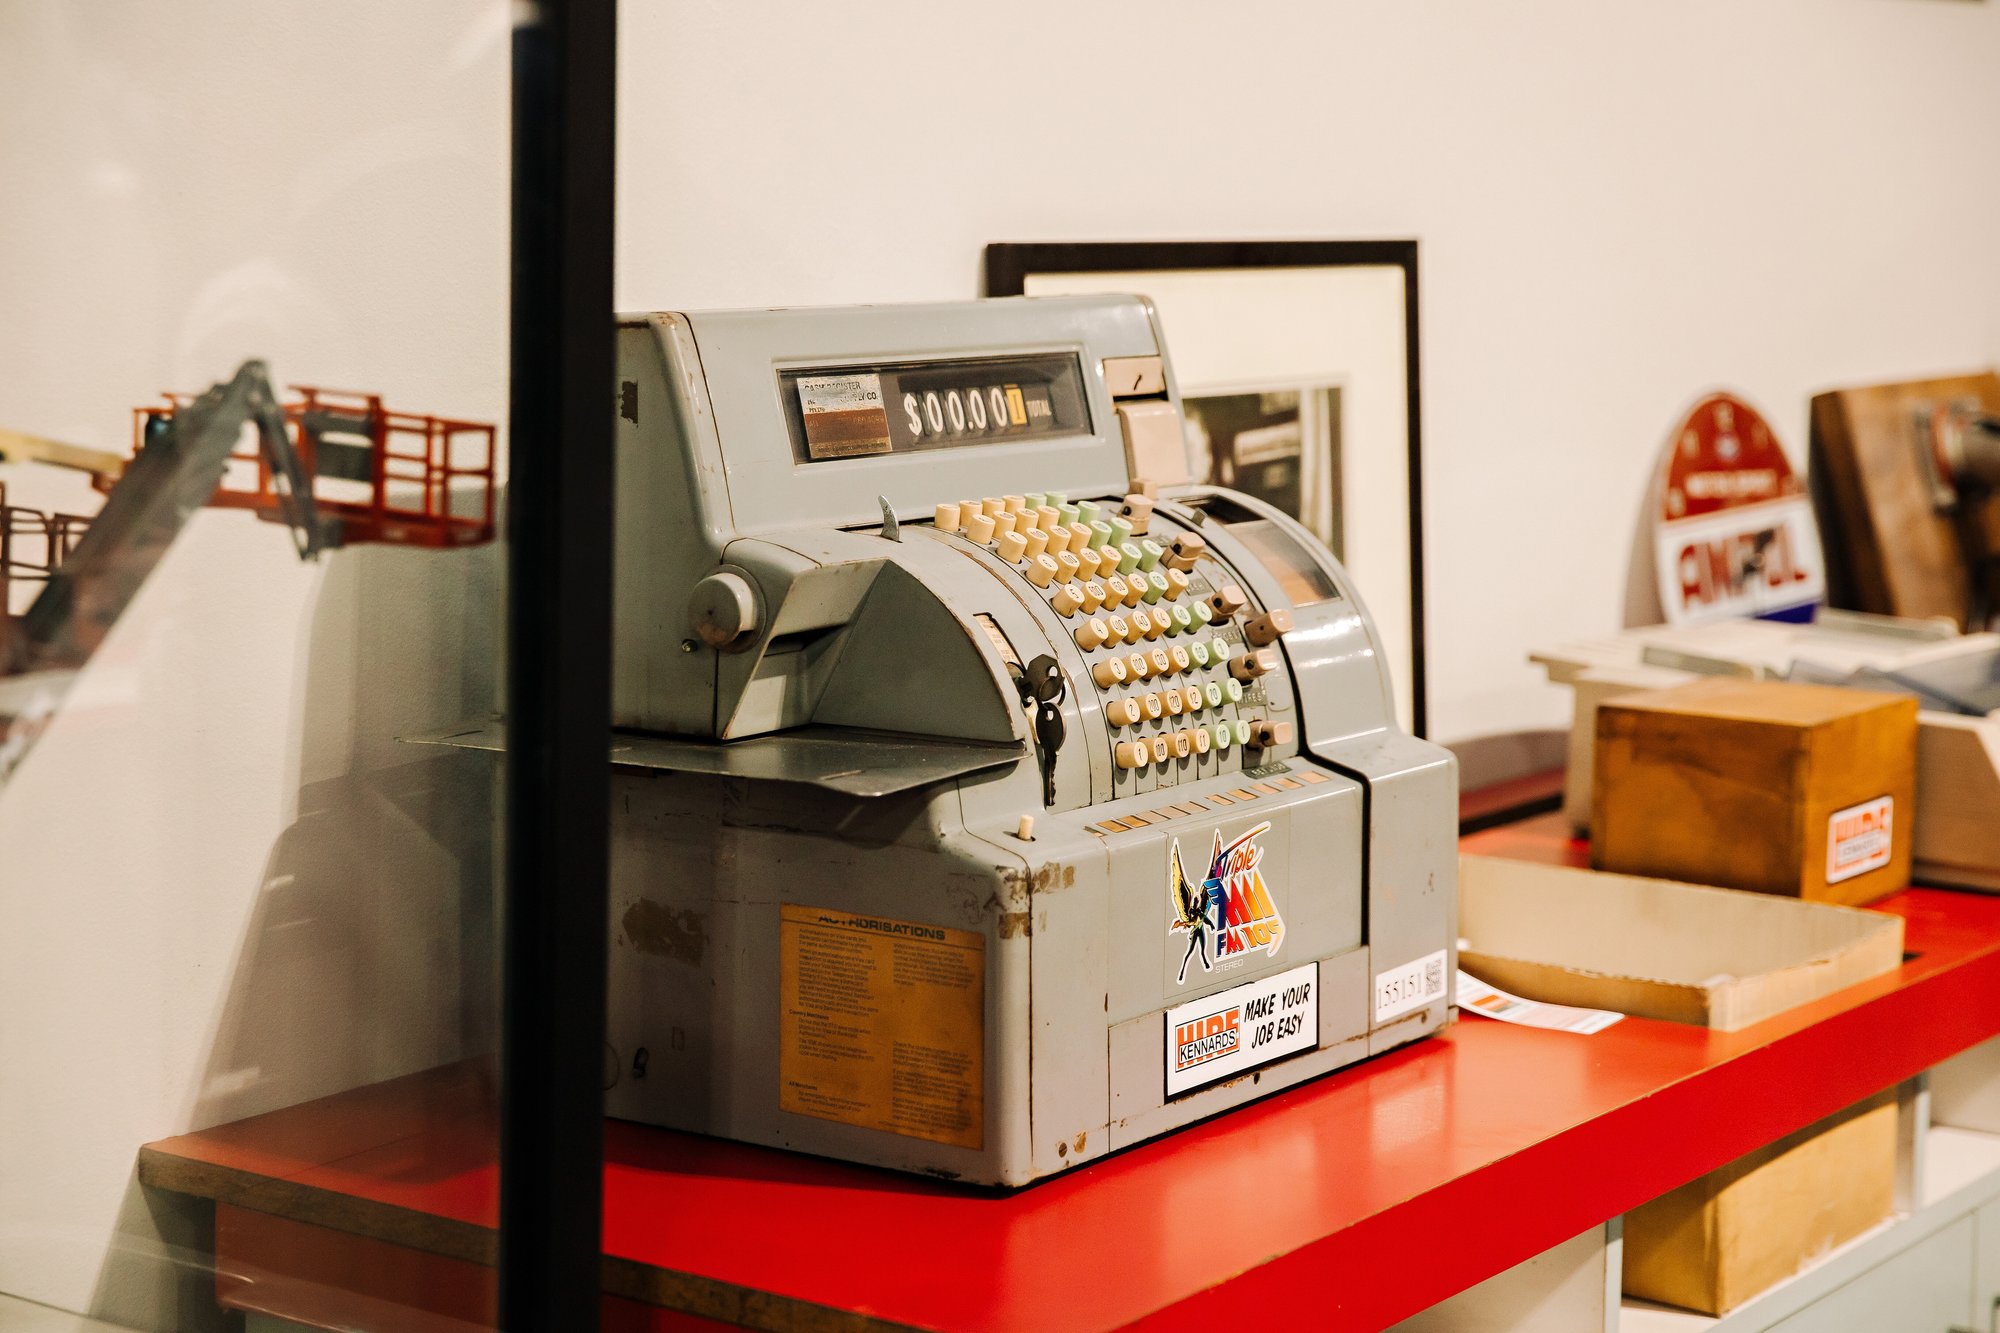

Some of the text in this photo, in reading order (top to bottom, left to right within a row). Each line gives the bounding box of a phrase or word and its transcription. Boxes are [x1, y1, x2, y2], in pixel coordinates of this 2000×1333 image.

[1189, 692, 1198, 704] 12
[1155, 743, 1165, 757] 100
[1177, 739, 1187, 752] 110
[1199, 735, 1207, 747] 11
[1219, 730, 1226, 743] 10
[1216, 826, 1269, 880] Triple
[818, 915, 946, 940] AUHORISATIONS
[1215, 959, 1243, 974] STEREO
[1244, 982, 1311, 1023] MAKE YOUR
[1378, 972, 1422, 1009] 155151
[1180, 1030, 1237, 1062] KENNARDS
[1251, 1011, 1305, 1049] JOB EASY
